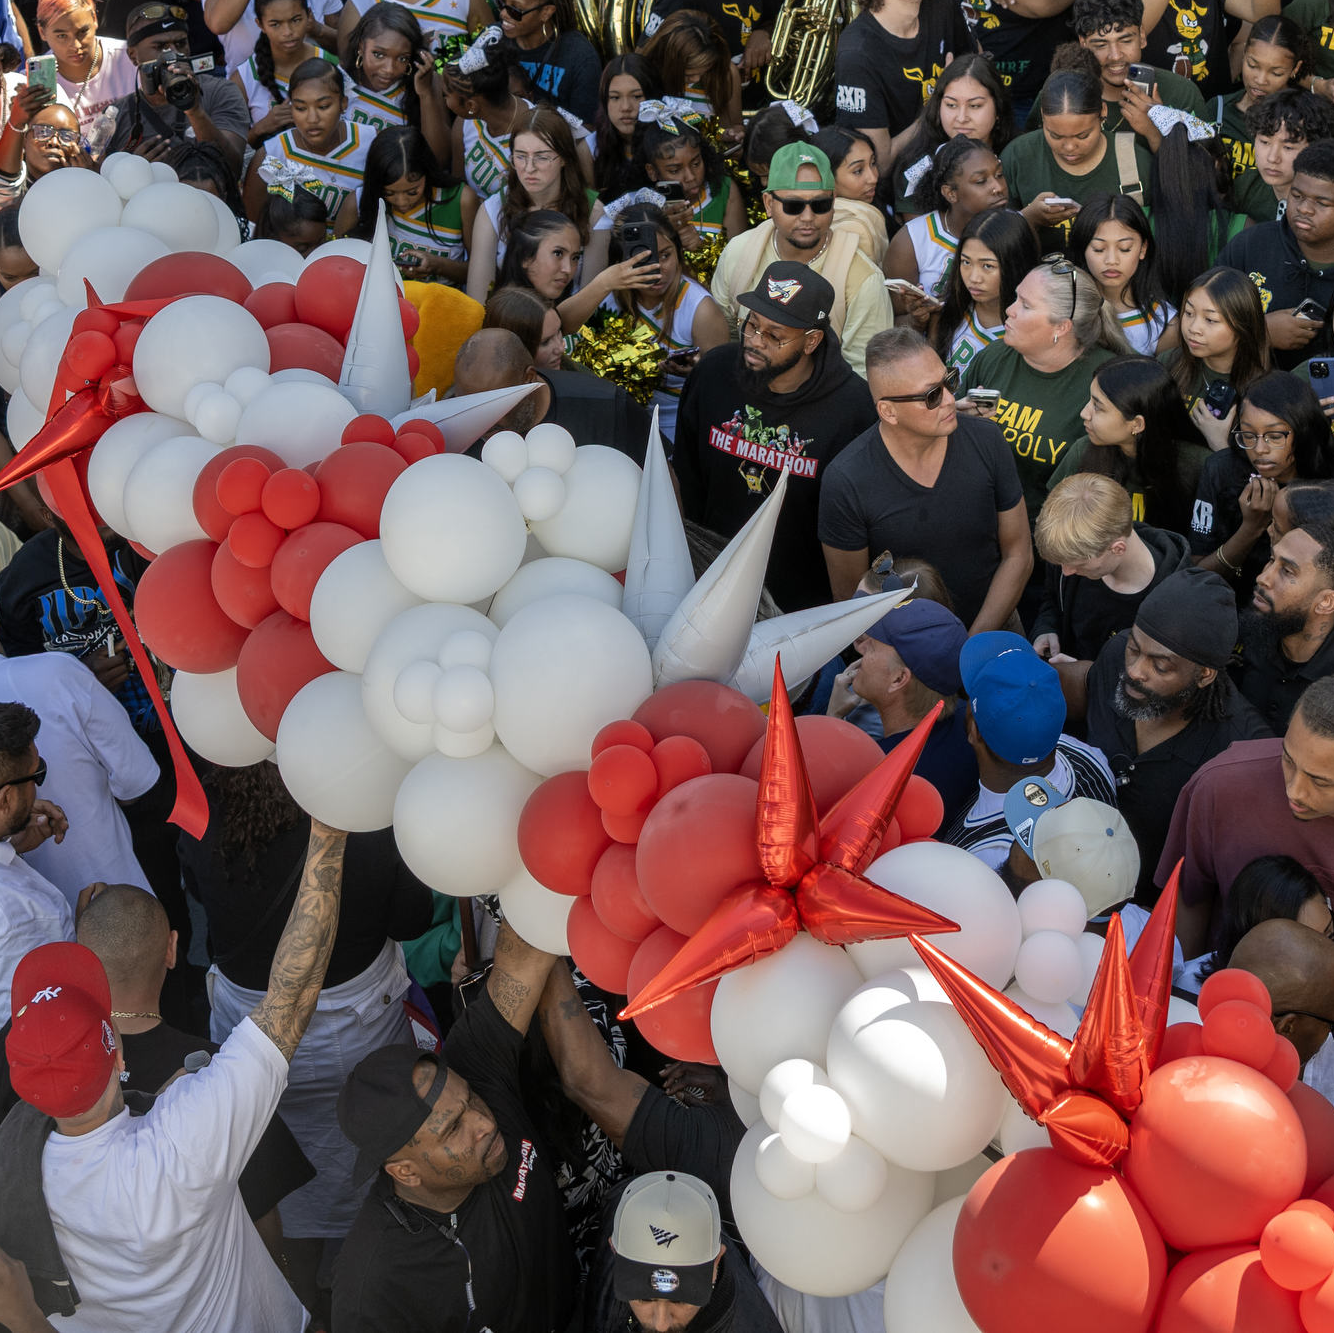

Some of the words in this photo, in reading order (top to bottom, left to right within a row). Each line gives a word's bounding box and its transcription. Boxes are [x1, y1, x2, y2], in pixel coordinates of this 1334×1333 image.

[463, 140, 511, 200] POL
[710, 427, 733, 453] THE
[735, 438, 817, 477] MARATHON
[1002, 427, 1068, 465] POLY
[514, 1139, 532, 1201] MARATHON
